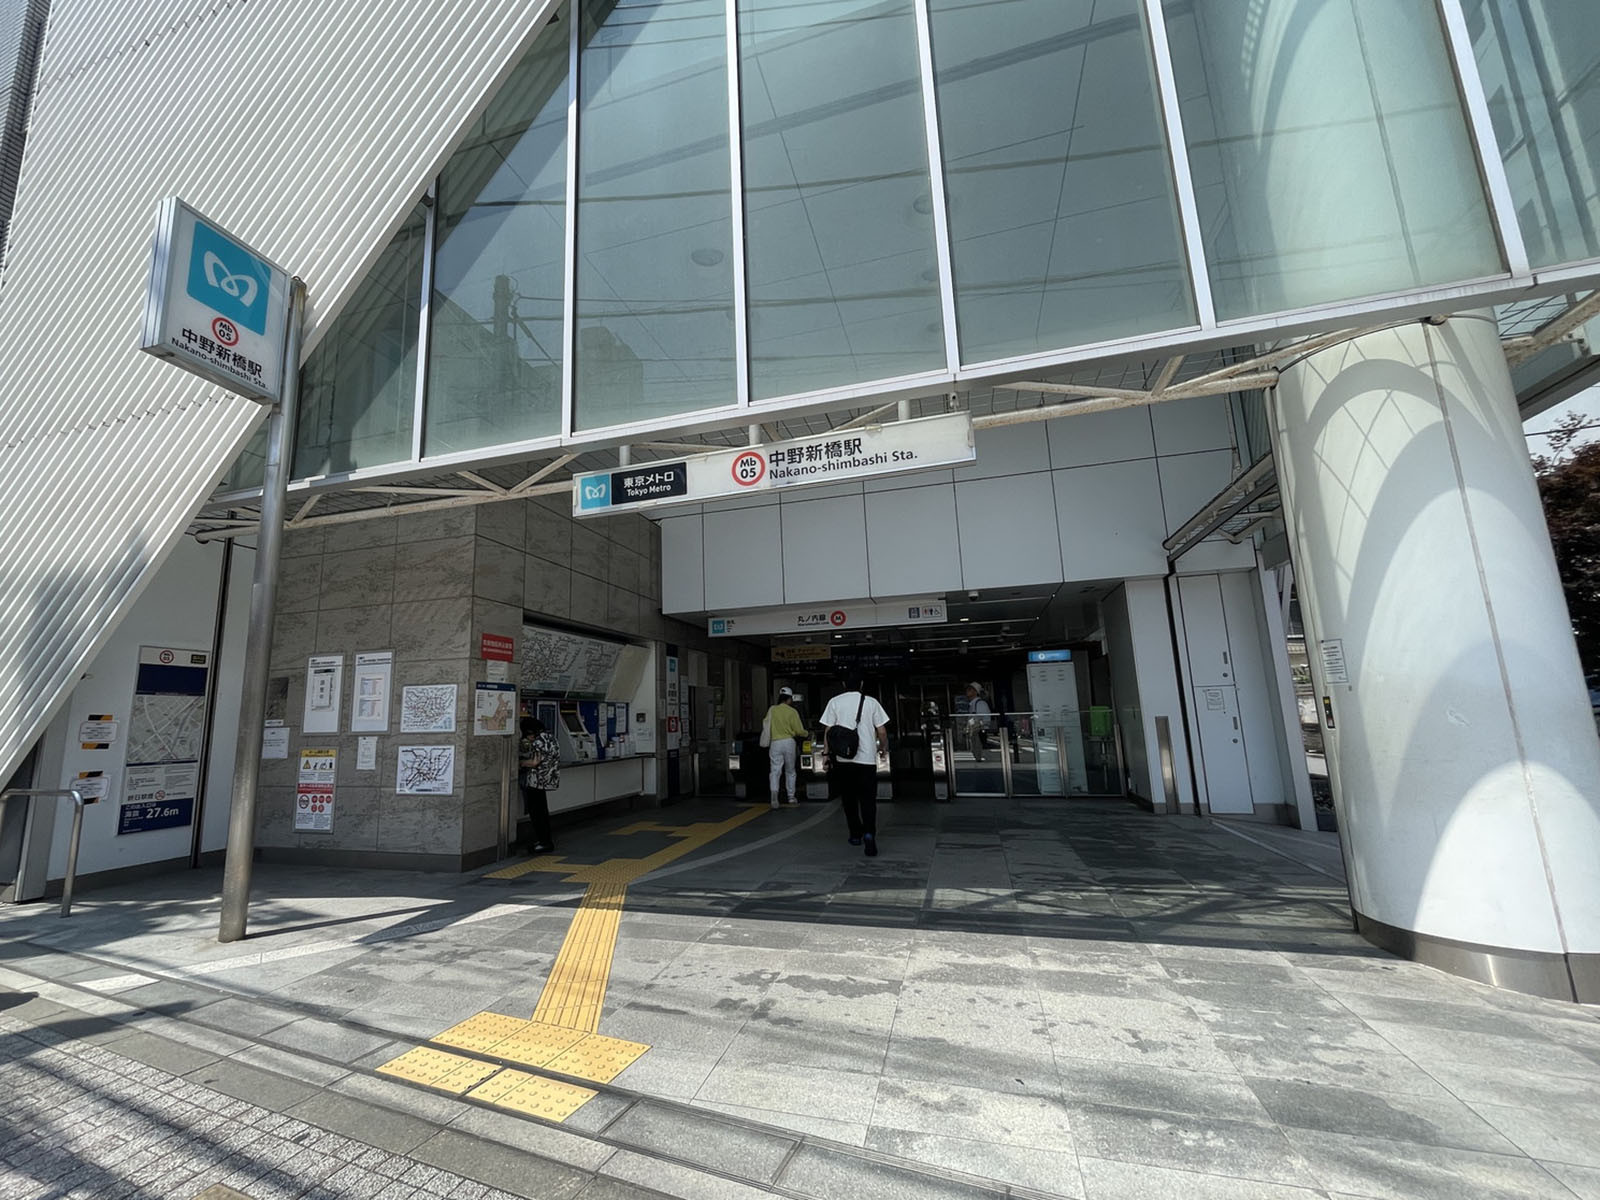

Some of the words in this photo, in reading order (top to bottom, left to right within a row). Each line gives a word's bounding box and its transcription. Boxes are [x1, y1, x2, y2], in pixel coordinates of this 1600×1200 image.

[219, 322, 233, 333] Mb
[219, 329, 232, 341] 05
[182, 328, 262, 378] 中野新橋駅
[172, 337, 252, 381] Nakano-shimbashi
[253, 378, 268, 390] Sta.
[769, 438, 863, 467] 中野新橋駅
[740, 457, 757, 468] Mb
[769, 452, 887, 480] Nakano-shimbashi
[892, 450, 918, 462] Sta.
[623, 471, 674, 489] 東京メトロ
[740, 468, 757, 479] 05
[627, 488, 648, 497] Tokyo
[649, 484, 671, 493] Metro
[146, 807, 179, 819] 27.6m
